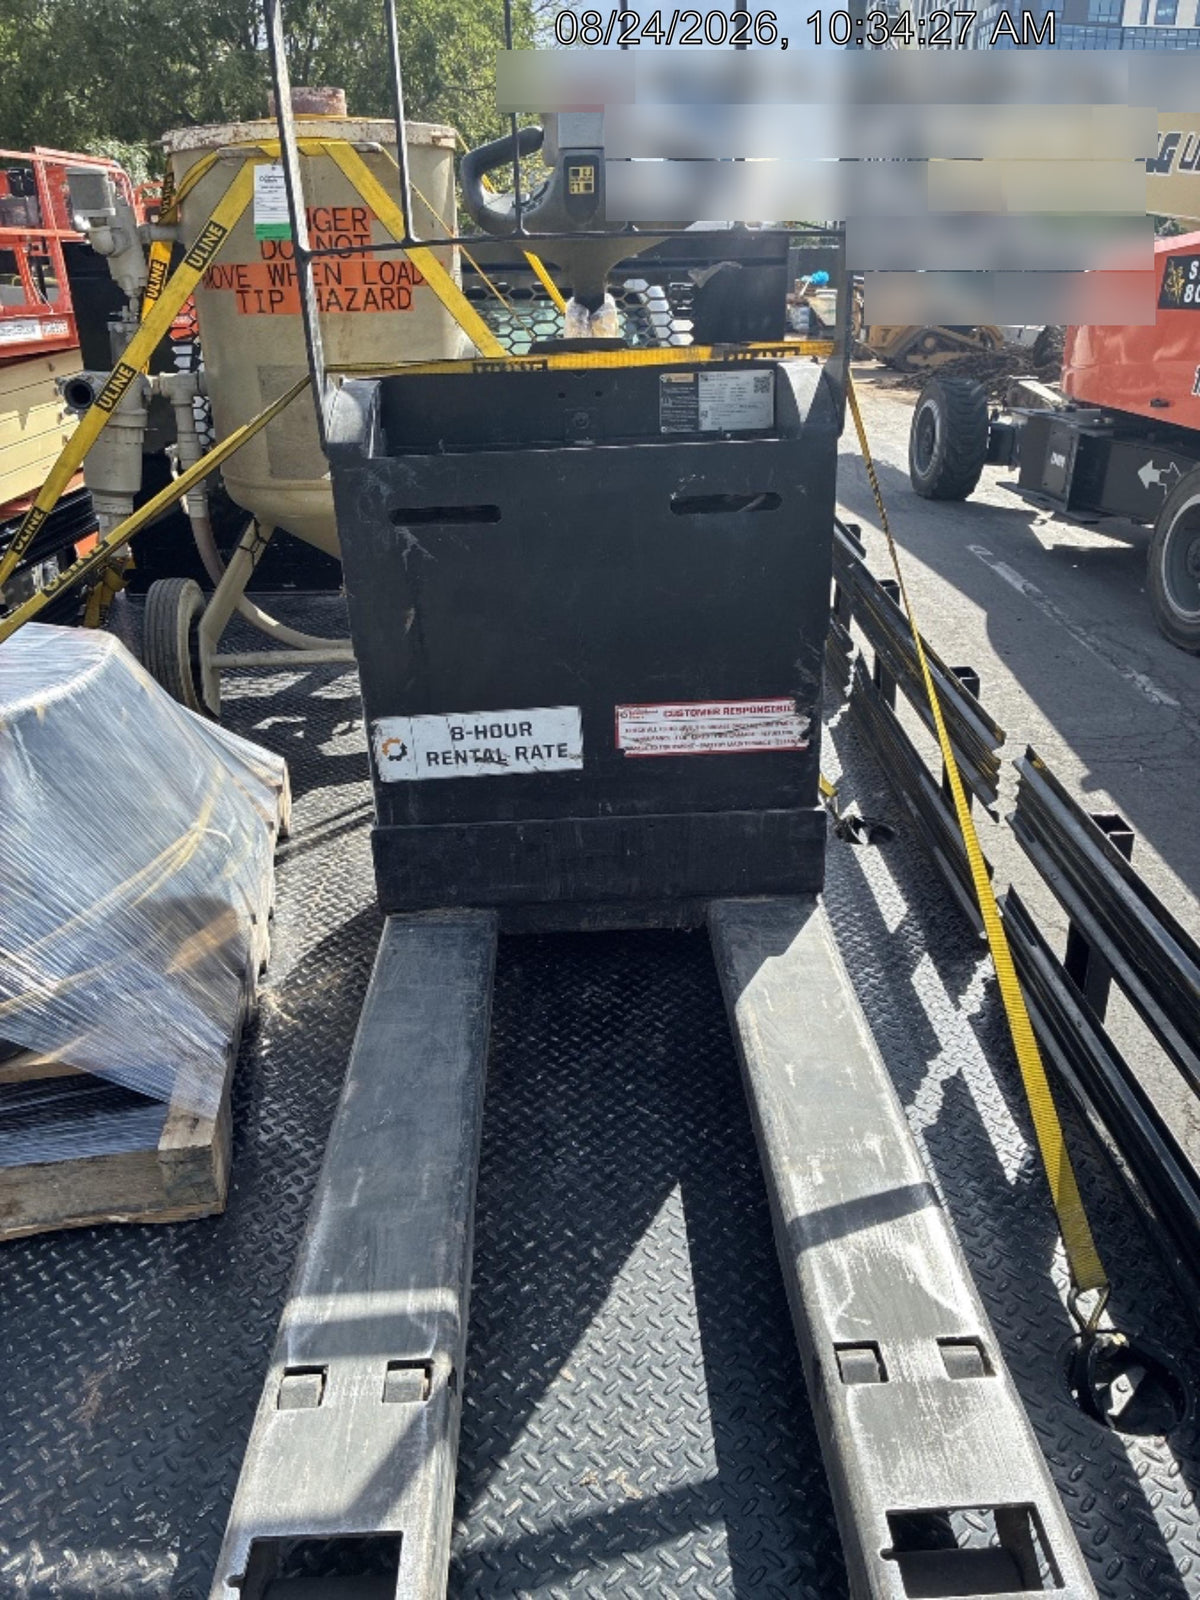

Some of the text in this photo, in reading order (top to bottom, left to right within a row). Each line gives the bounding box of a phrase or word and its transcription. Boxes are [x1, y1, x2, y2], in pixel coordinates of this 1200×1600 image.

[306, 207, 368, 232] GER
[188, 222, 224, 268] ULINE
[316, 234, 370, 259] NOT
[147, 261, 166, 299] ULINE
[267, 261, 342, 287] WHEN
[236, 289, 284, 314] TIP
[100, 364, 135, 409] ULINE
[451, 721, 533, 741] 8-HOUR
[426, 743, 568, 767] RENTAL RATE
